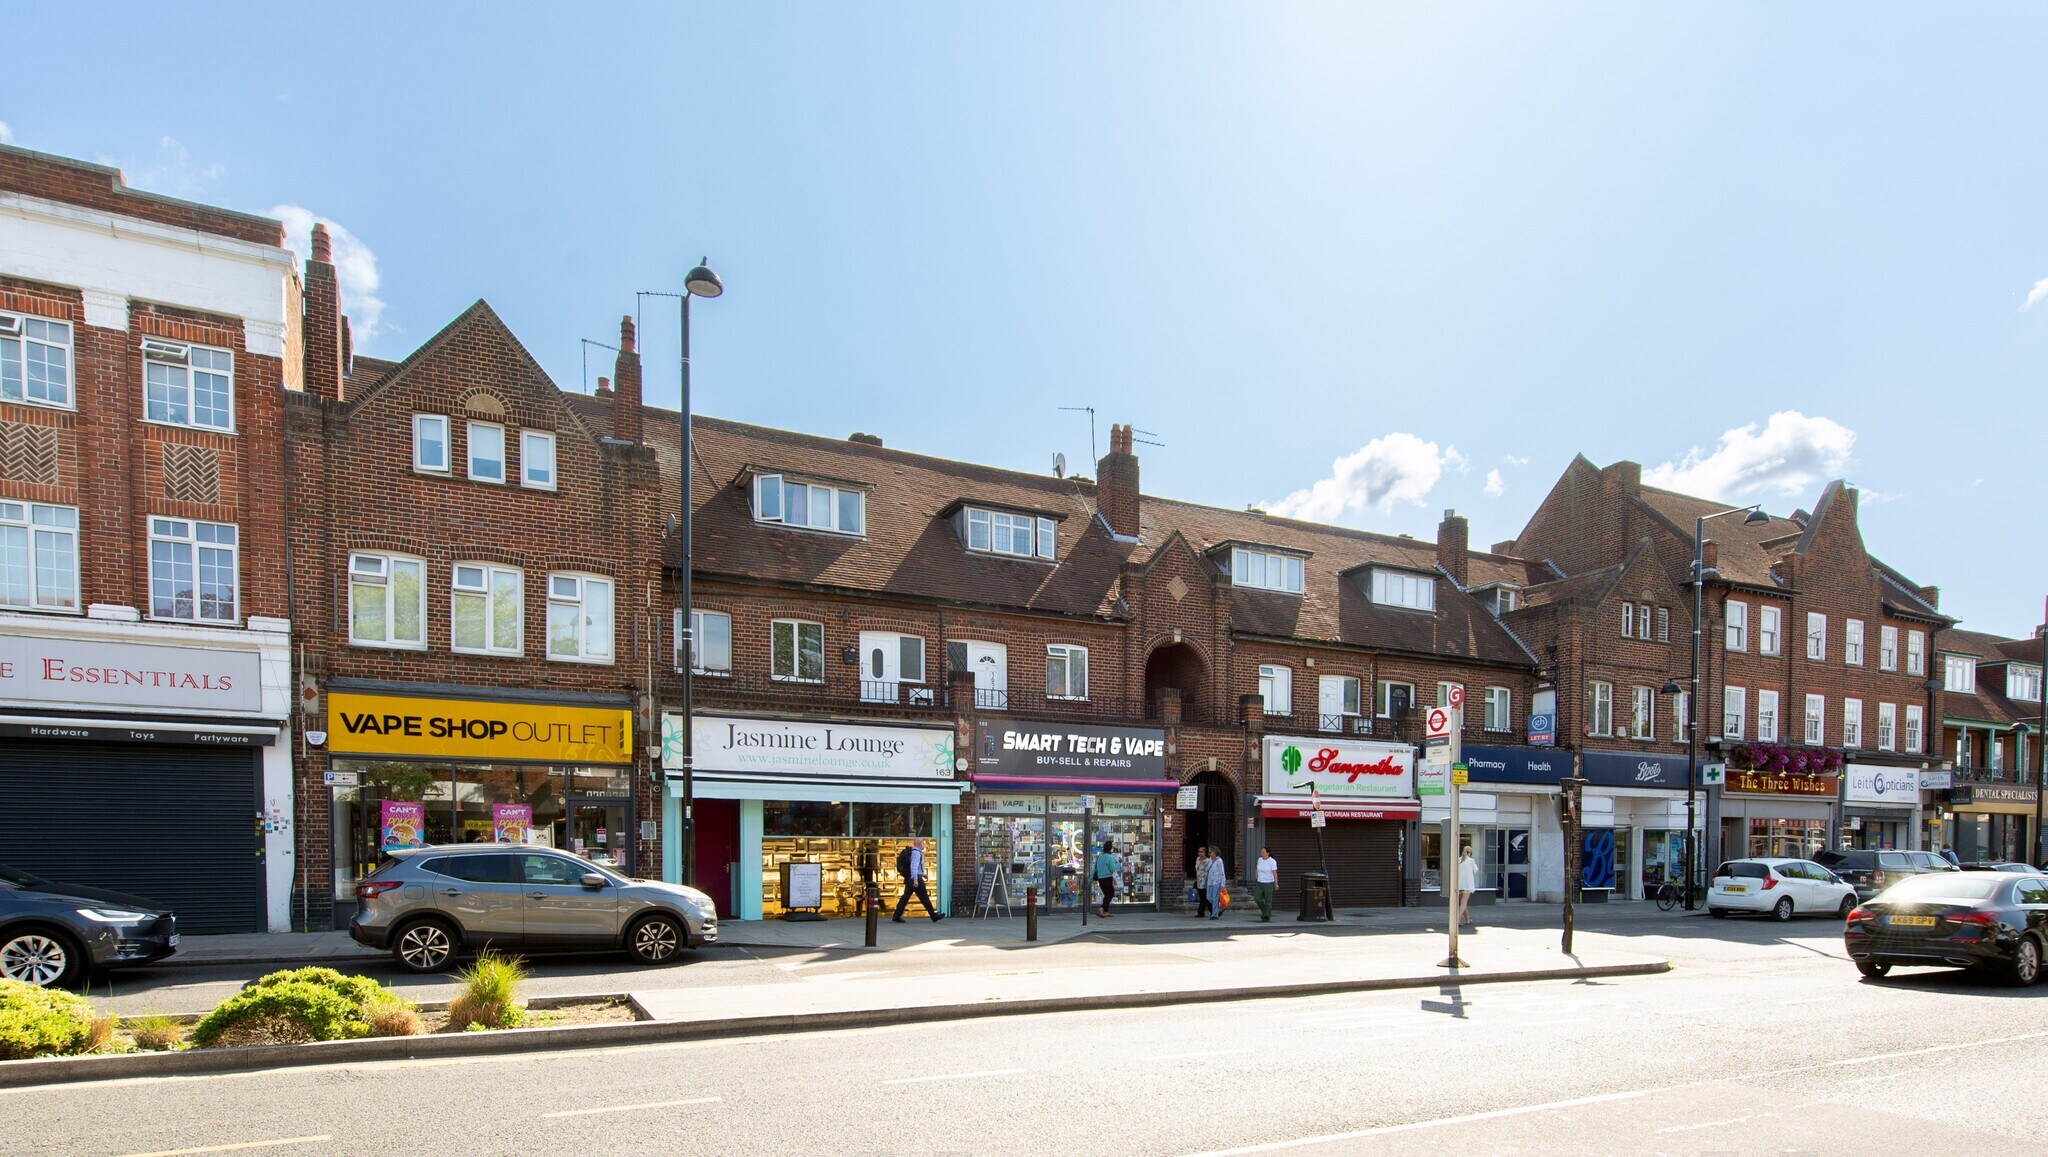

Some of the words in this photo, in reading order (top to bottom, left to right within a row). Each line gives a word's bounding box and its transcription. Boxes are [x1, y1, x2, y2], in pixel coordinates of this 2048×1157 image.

[41, 658, 232, 690] ESSENTIALS
[1449, 689, 1460, 702] G
[31, 727, 89, 737] Hardware
[129, 731, 155, 740] Toys
[194, 734, 249, 743] Partyware
[340, 713, 422, 736] VAPE
[429, 717, 507, 739] SHOP
[512, 721, 612, 745] OUTLET
[723, 724, 817, 750] Jasmine
[824, 729, 905, 758] Lounge
[1003, 731, 1062, 752] SMART
[1067, 734, 1107, 755] TECH
[1111, 737, 1121, 754] &
[1125, 737, 1164, 757] VAPE
[737, 751, 892, 769] www.jasminelounge.co.uk
[1036, 756, 1081, 766] BUY-SELL
[1084, 758, 1090, 766] &
[1093, 758, 1132, 768] REPAIRS
[1308, 748, 1403, 783] Sangeetha
[1469, 758, 1506, 771] Pharmacy
[1527, 761, 1551, 771] Health
[1635, 761, 1661, 781] Boots
[1356, 784, 1397, 793] Restaurant
[1740, 775, 1758, 789] The
[1761, 776, 1789, 790] Three
[1792, 778, 1825, 792] Wishes
[1852, 776, 1874, 789] Leith
[1975, 788, 1999, 799] DENTAL
[2001, 790, 2038, 801] SPECIALISTS
[1104, 802, 1142, 810] PERFUMES
[1890, 916, 1914, 924] AK69
[1915, 917, 1934, 925] SPV
